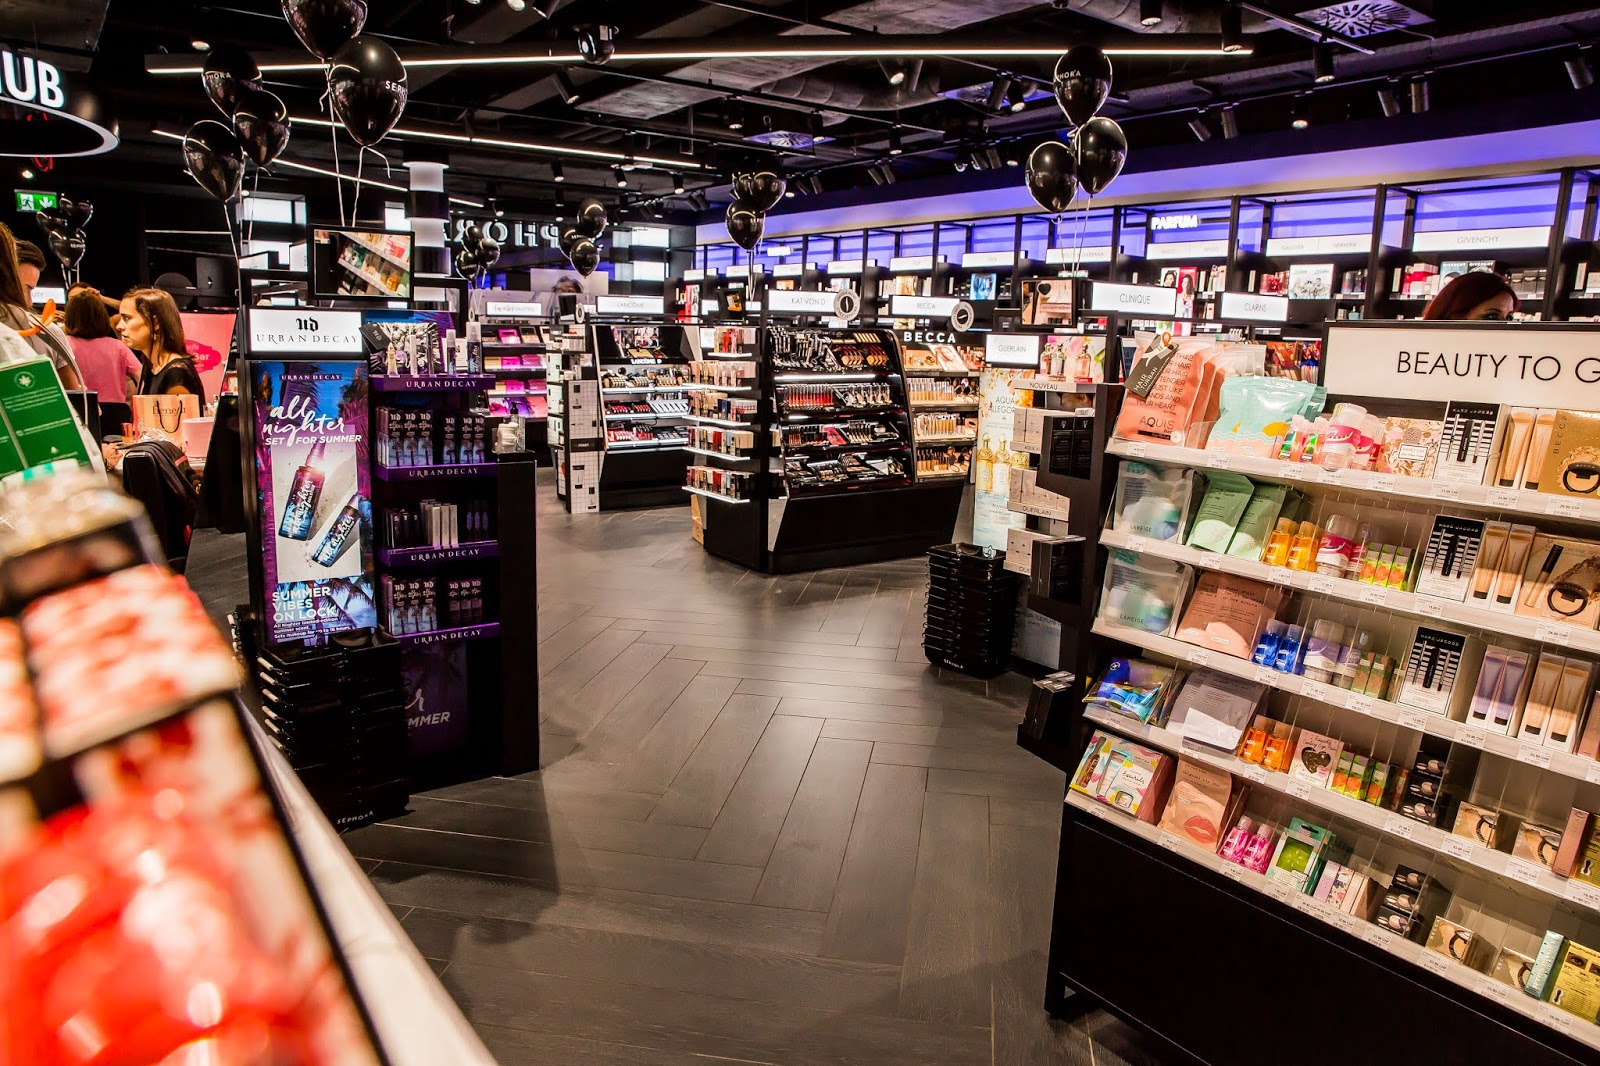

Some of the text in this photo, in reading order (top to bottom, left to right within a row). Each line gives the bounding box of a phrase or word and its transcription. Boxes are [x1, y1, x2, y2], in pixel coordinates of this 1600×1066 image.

[0, 50, 65, 108] UB
[1151, 214, 1198, 230] PARFUM
[1457, 236, 1500, 244] GIVENCHY
[1119, 293, 1151, 305] CLINIQUE
[1244, 302, 1267, 312] CLARINS
[256, 334, 358, 344] URBAN DECAY
[904, 331, 957, 343] BECCA
[998, 344, 1027, 354] GUERLAIN
[1174, 362, 1192, 370] HAIR
[1397, 351, 1600, 384] BEAUTY TO G
[1133, 373, 1148, 391] HAIR
[1140, 366, 1158, 390] TURBAN
[406, 380, 477, 389] URBAN DECAY
[1029, 382, 1058, 391] NOUVEAU
[1168, 386, 1184, 395] LIKE
[995, 396, 1015, 405] AQUA
[1166, 394, 1181, 403] AND
[152, 405, 187, 417] Benefit
[270, 394, 311, 419] all
[987, 405, 1015, 414] ALLEGOR
[262, 410, 345, 447] nighter
[1139, 415, 1175, 430] AQUIS
[265, 434, 363, 446] SET FOR SUMMER
[1553, 416, 1567, 455] BECCA
[409, 470, 444, 478] URBAN
[1022, 505, 1052, 516] GUERLAIN
[1129, 523, 1152, 533] LANEIGE
[410, 548, 480, 562] URBAN DECAY
[272, 586, 332, 601] SUMMER
[272, 598, 314, 612] VIBES
[273, 611, 295, 623] ON
[1119, 613, 1145, 625] LANEIGE
[413, 629, 482, 645] URBAN DECAY
[408, 711, 451, 728] MMER
[337, 810, 374, 825] SEPHORA
